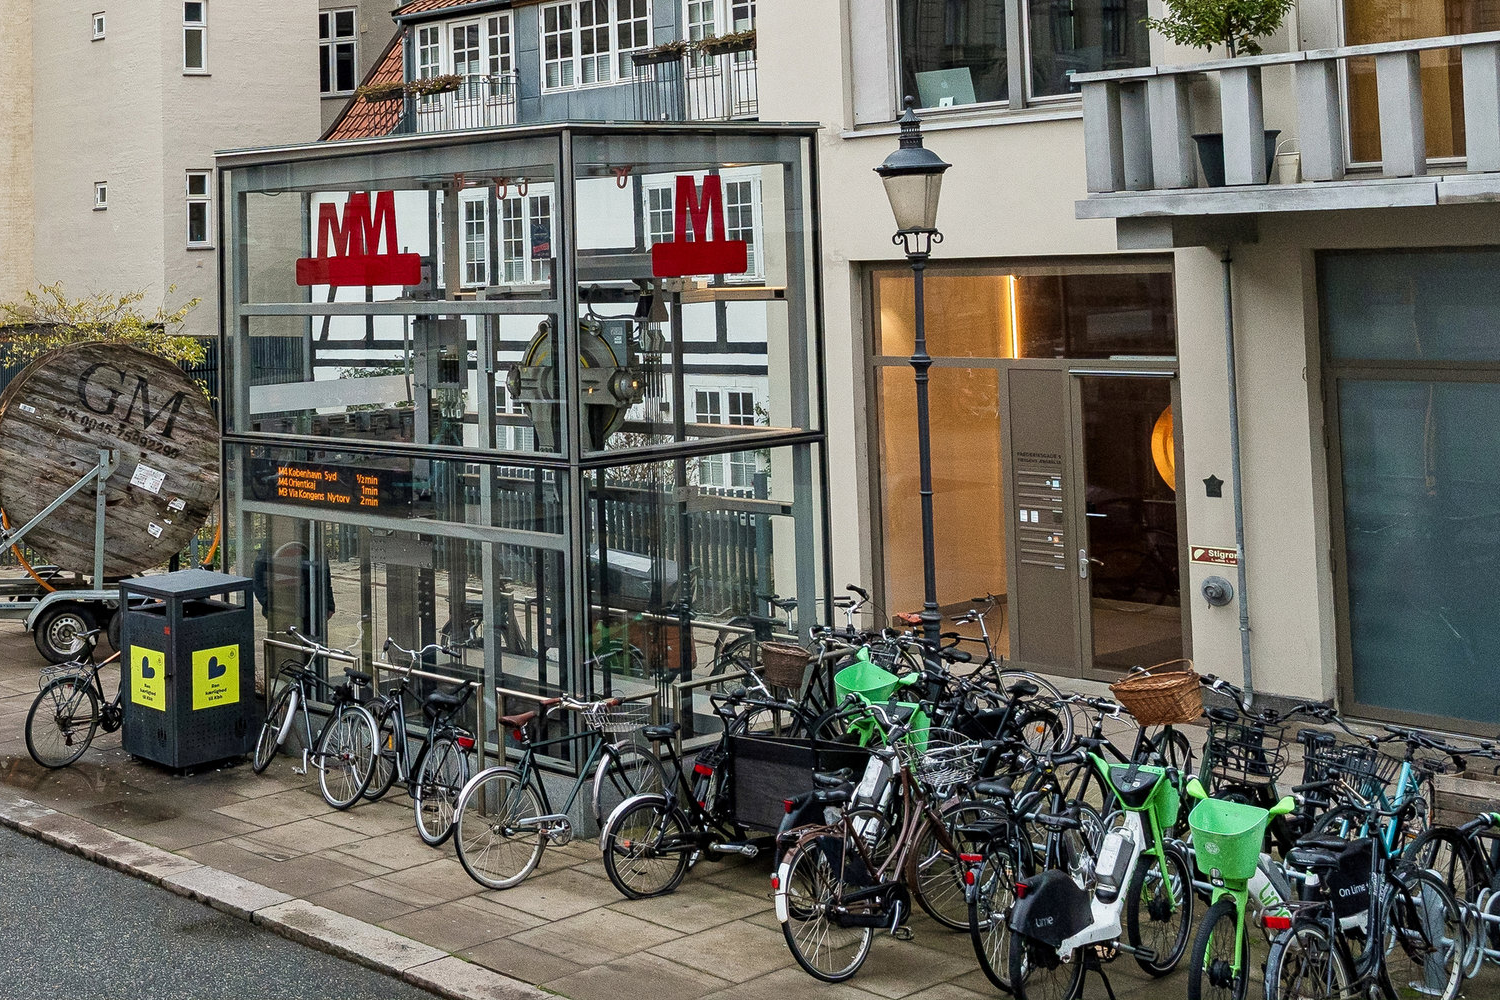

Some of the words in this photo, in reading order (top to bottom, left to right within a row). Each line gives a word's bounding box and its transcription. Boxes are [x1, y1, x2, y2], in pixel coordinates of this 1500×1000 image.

[78, 362, 192, 440] GM
[278, 467, 288, 476] M4
[324, 471, 337, 481] Syd
[278, 477, 288, 486] M4
[288, 478, 316, 490] Orientkaj
[278, 488, 288, 497] M3
[288, 488, 298, 498] Via
[298, 489, 325, 501] Kongens
[327, 492, 350, 503] Nytorv
[1338, 887, 1351, 898] On
[1351, 883, 1366, 895] Lime
